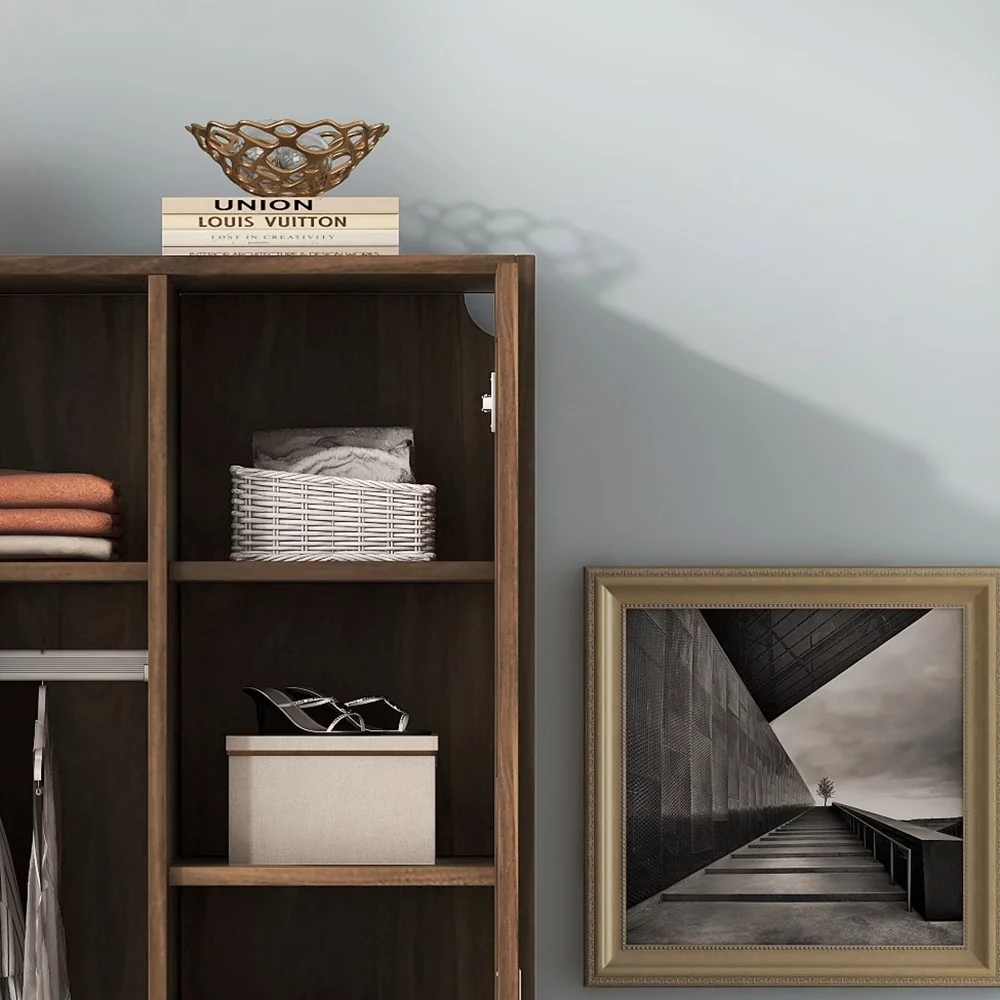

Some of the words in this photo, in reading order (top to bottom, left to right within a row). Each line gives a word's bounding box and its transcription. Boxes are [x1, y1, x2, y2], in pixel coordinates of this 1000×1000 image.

[214, 199, 313, 211] UNION
[199, 216, 254, 228] LOUIS
[265, 216, 347, 228] VUITTON
